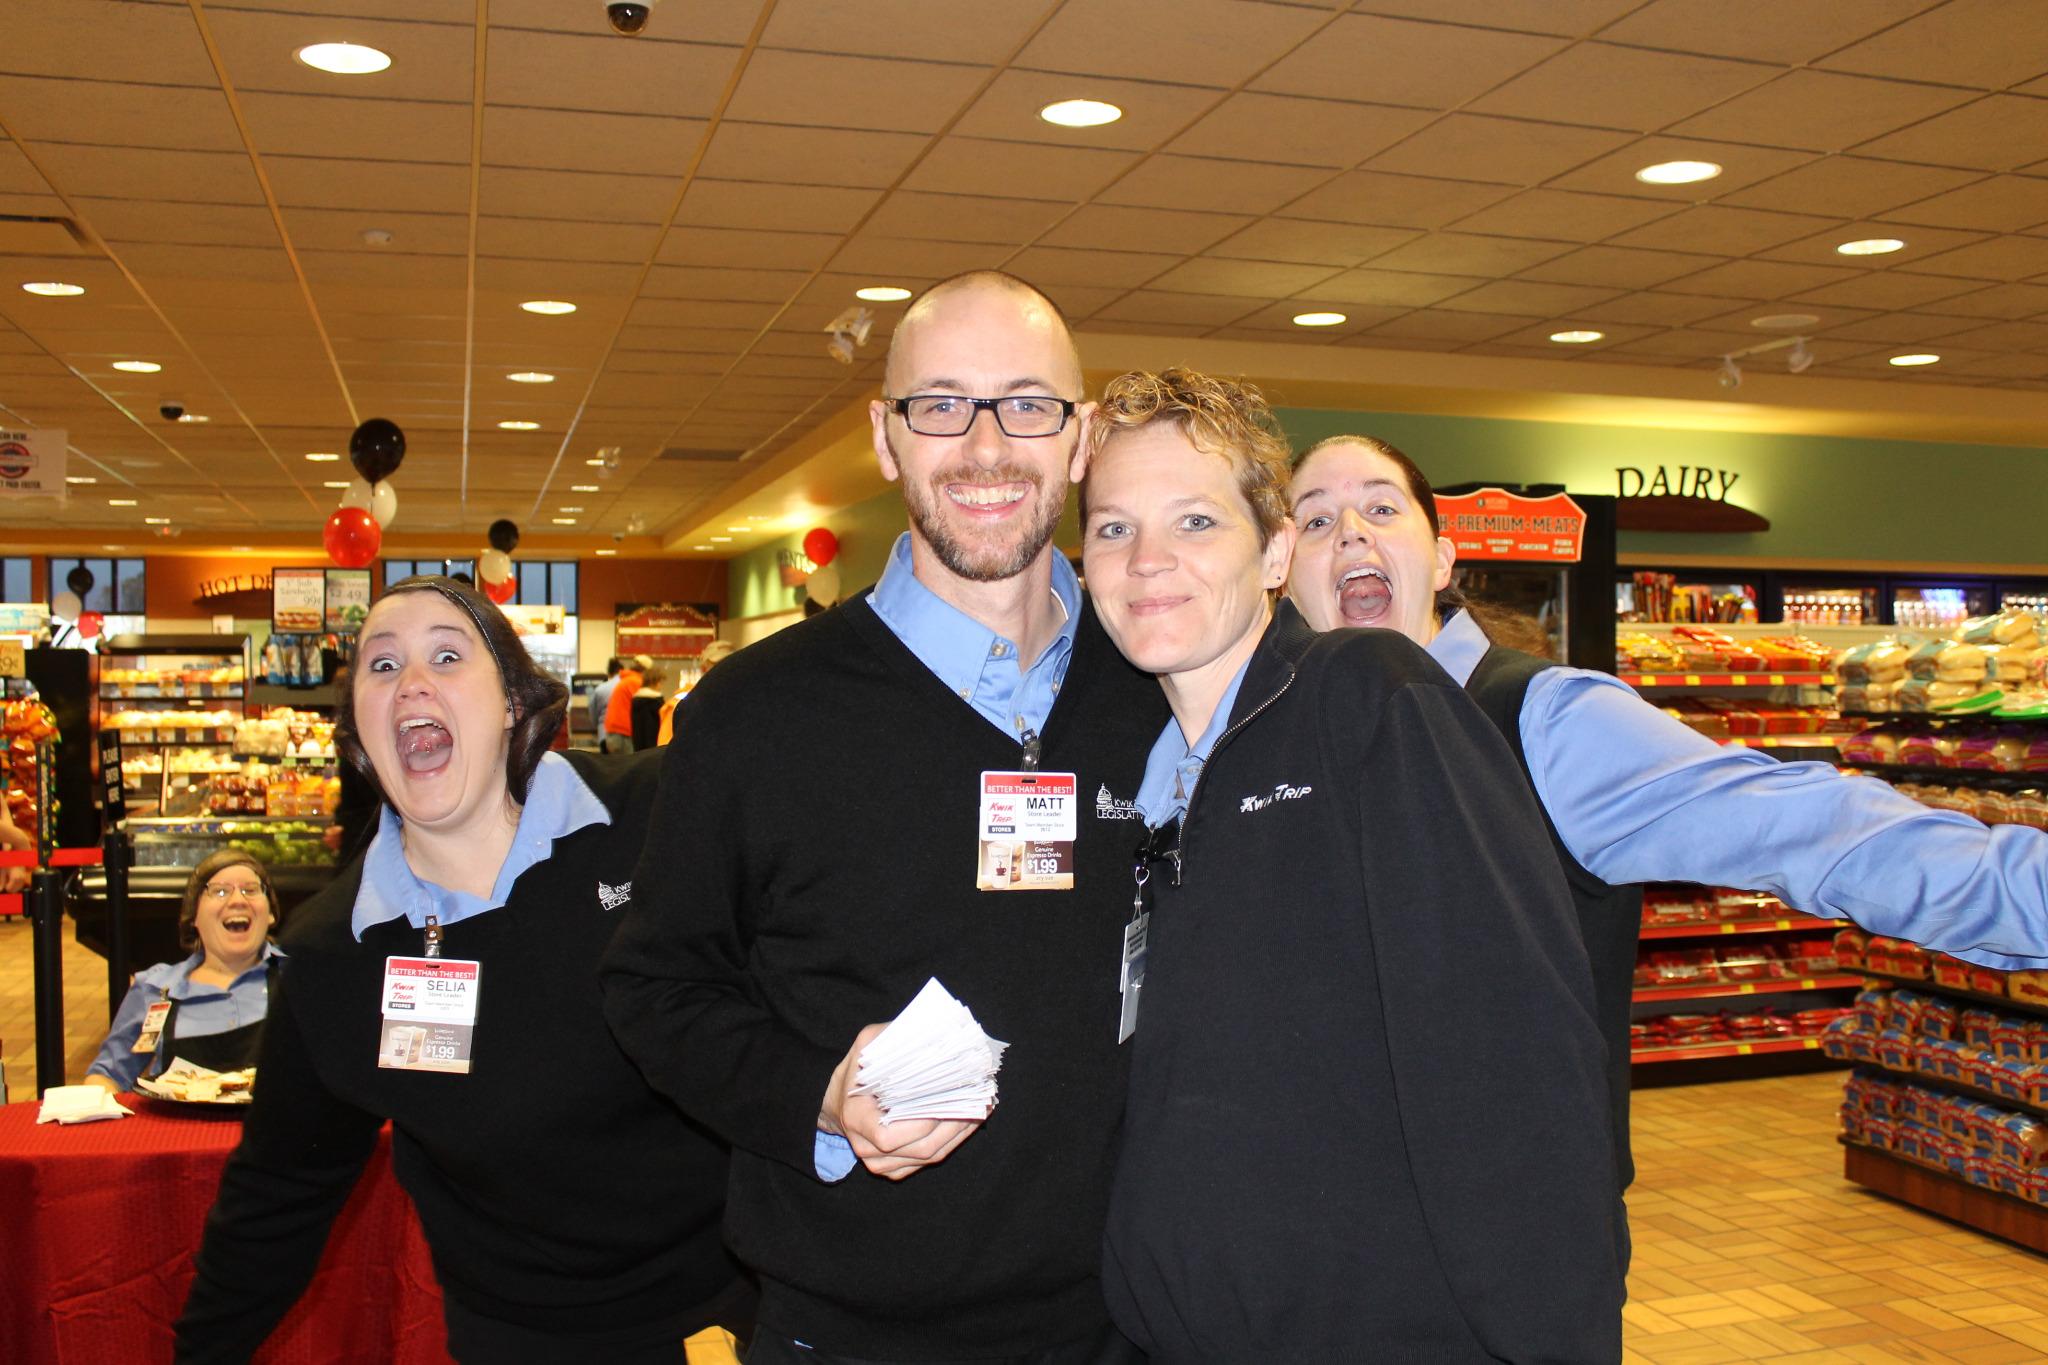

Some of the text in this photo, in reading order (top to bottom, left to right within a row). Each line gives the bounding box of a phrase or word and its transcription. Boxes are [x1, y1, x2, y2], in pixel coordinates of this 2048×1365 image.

[1615, 464, 1740, 503] DAIRY
[1457, 514, 1524, 534] PREMIUM
[1532, 516, 1579, 534] MEATS
[199, 574, 243, 597] HOT
[987, 785, 1013, 793] BETTER
[1053, 786, 1072, 794] BEST!
[1026, 797, 1065, 809] MATT
[1114, 798, 1134, 807] KWIK
[1240, 784, 1312, 813] KWIK TRIP
[989, 802, 1014, 811] KWIK
[1027, 859, 1058, 874] $1.99
[391, 967, 474, 979] BETTER THAN THE BEST!
[392, 982, 415, 991] KWIK
[426, 979, 467, 992] SELIA
[392, 992, 413, 1001] TRIP
[426, 1045, 455, 1059] $1.99
